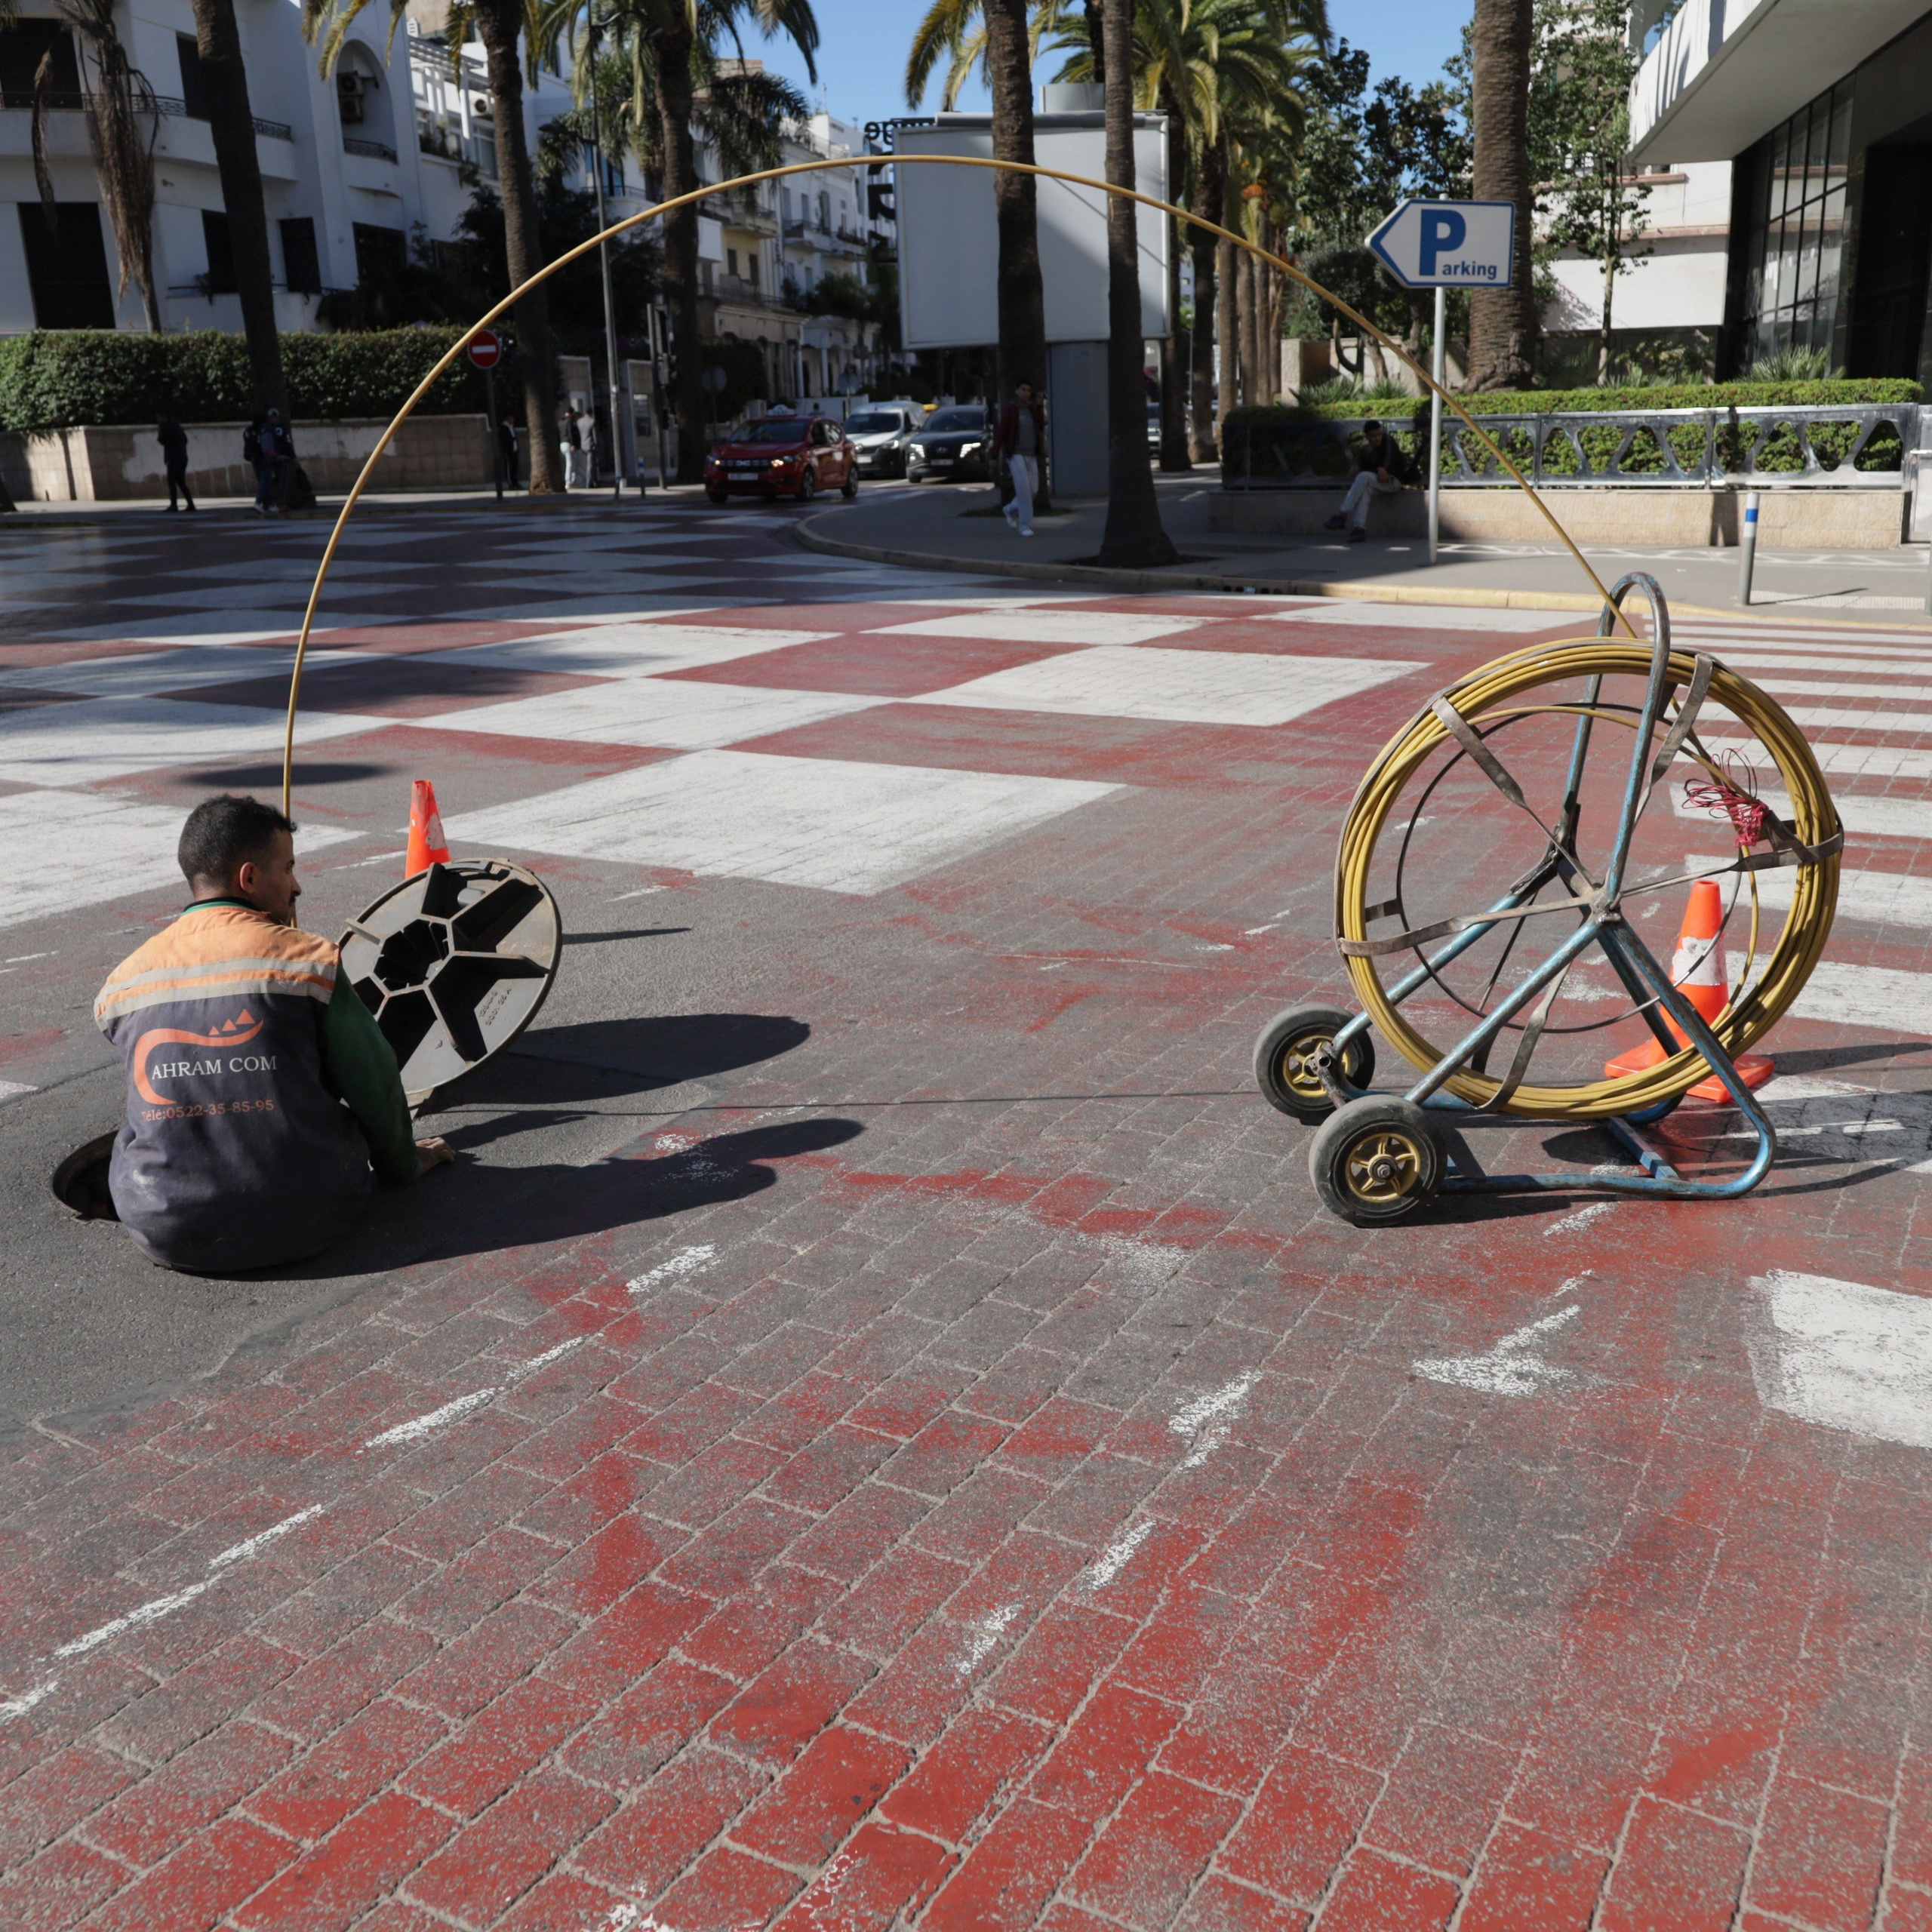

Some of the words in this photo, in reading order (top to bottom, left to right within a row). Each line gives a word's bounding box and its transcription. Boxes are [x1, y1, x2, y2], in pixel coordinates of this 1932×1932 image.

[1419, 208, 1497, 280] Parking
[152, 1059, 222, 1080] AHRAM
[229, 1056, 277, 1073] COM
